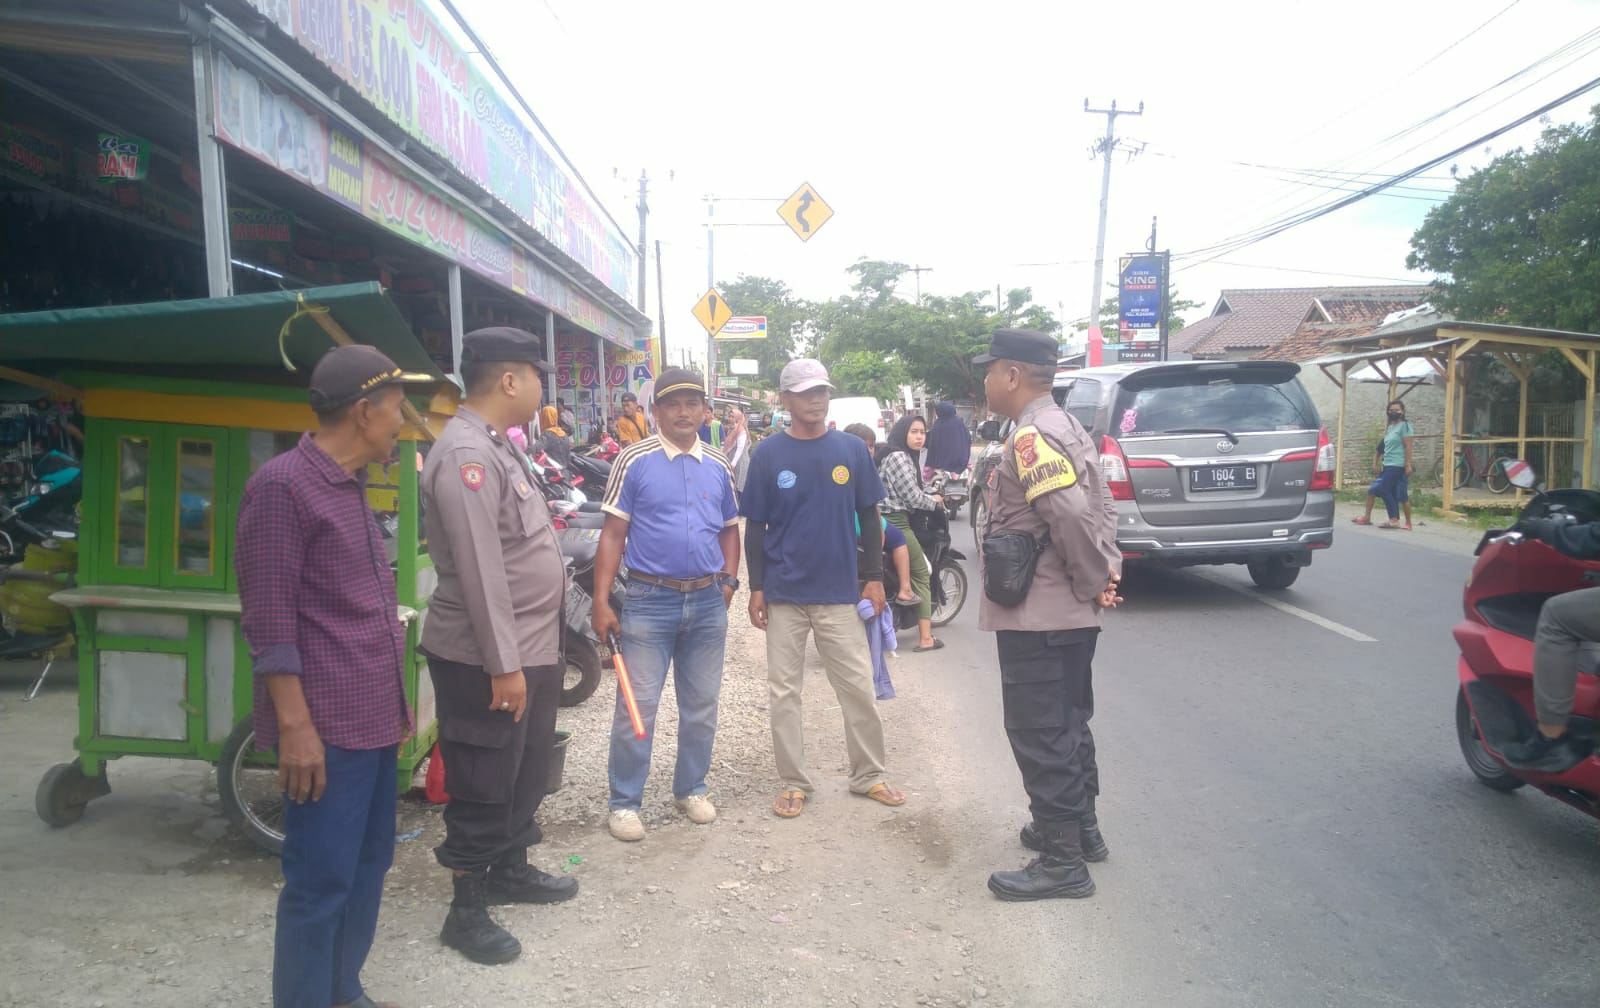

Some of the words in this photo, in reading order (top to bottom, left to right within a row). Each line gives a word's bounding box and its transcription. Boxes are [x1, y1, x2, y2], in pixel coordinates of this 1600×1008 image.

[328, 164, 361, 206] MURAH
[369, 158, 466, 255] RIZQIA
[1124, 276, 1158, 285] KING
[1193, 470, 1200, 482] T
[1211, 468, 1235, 481] 1604
